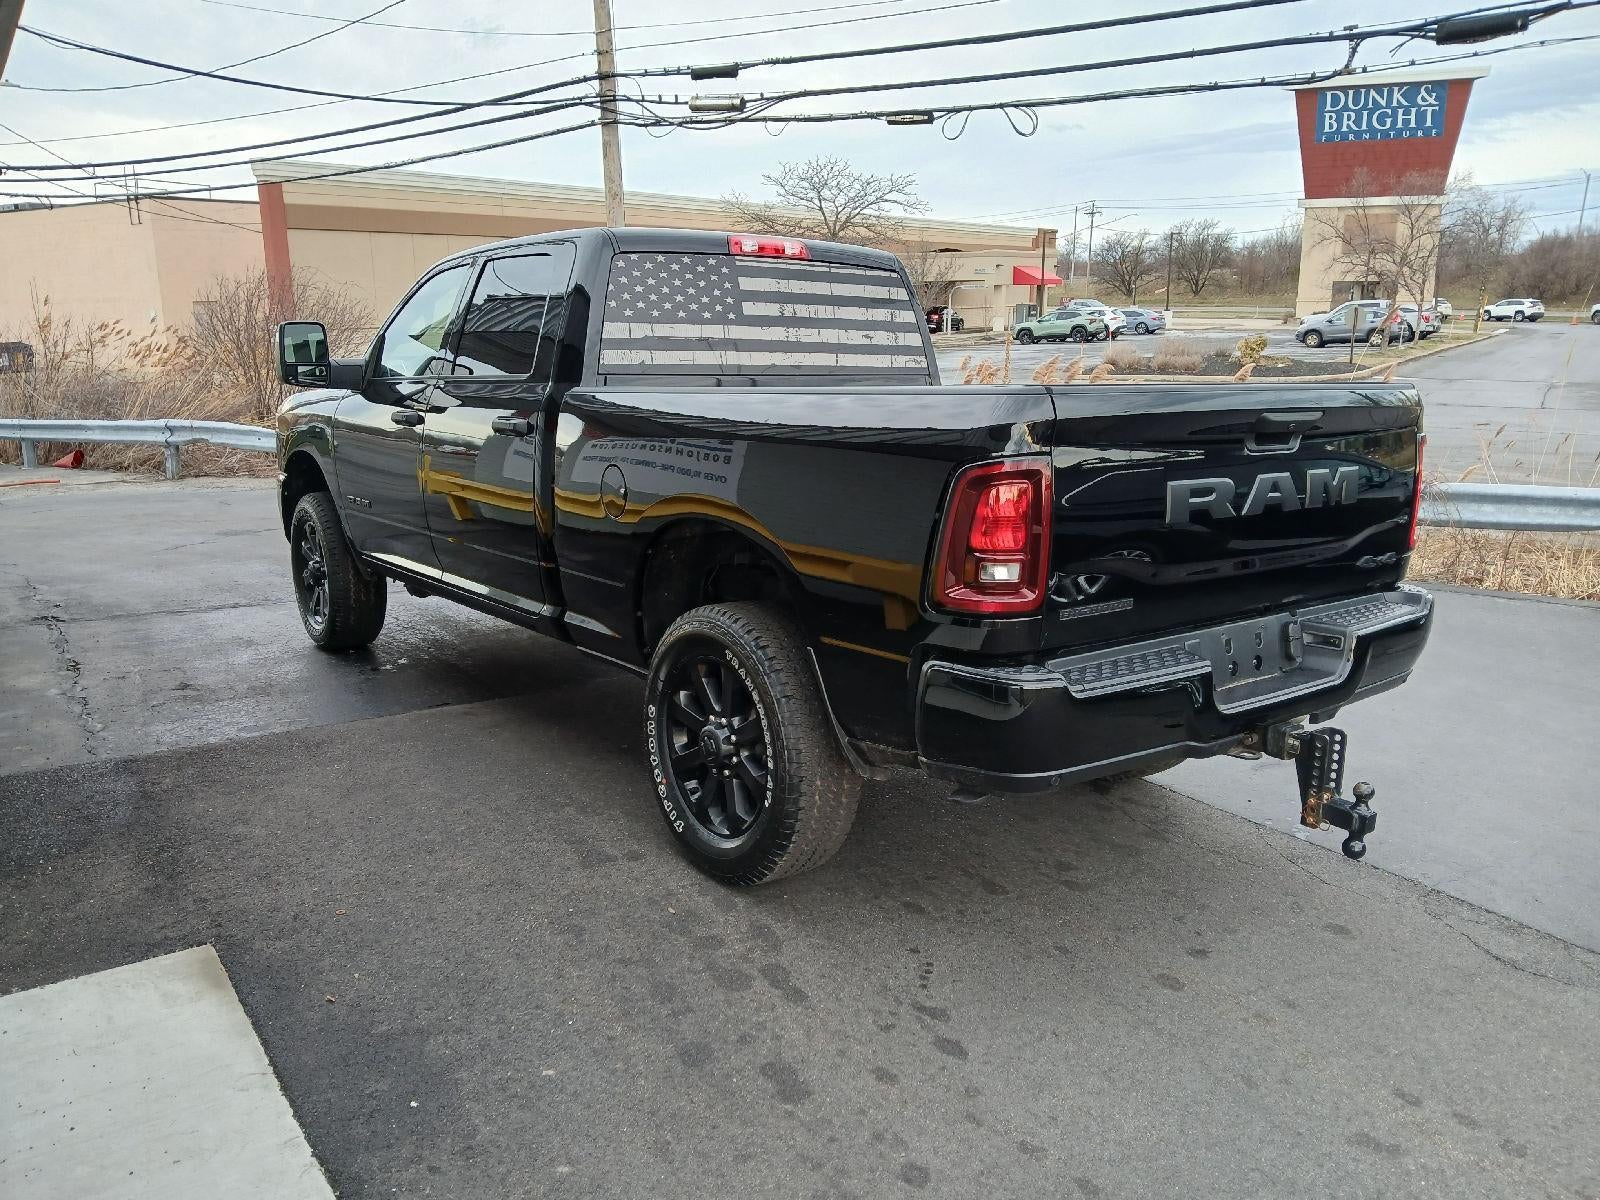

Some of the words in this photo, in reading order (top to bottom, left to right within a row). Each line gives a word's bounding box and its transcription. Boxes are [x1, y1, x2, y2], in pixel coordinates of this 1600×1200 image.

[1324, 86, 1411, 111] DUNK
[1416, 84, 1440, 105] &
[1323, 106, 1440, 133] BRIGHT
[1321, 129, 1439, 142] FURNITURE
[1165, 466, 1361, 525] RAM
